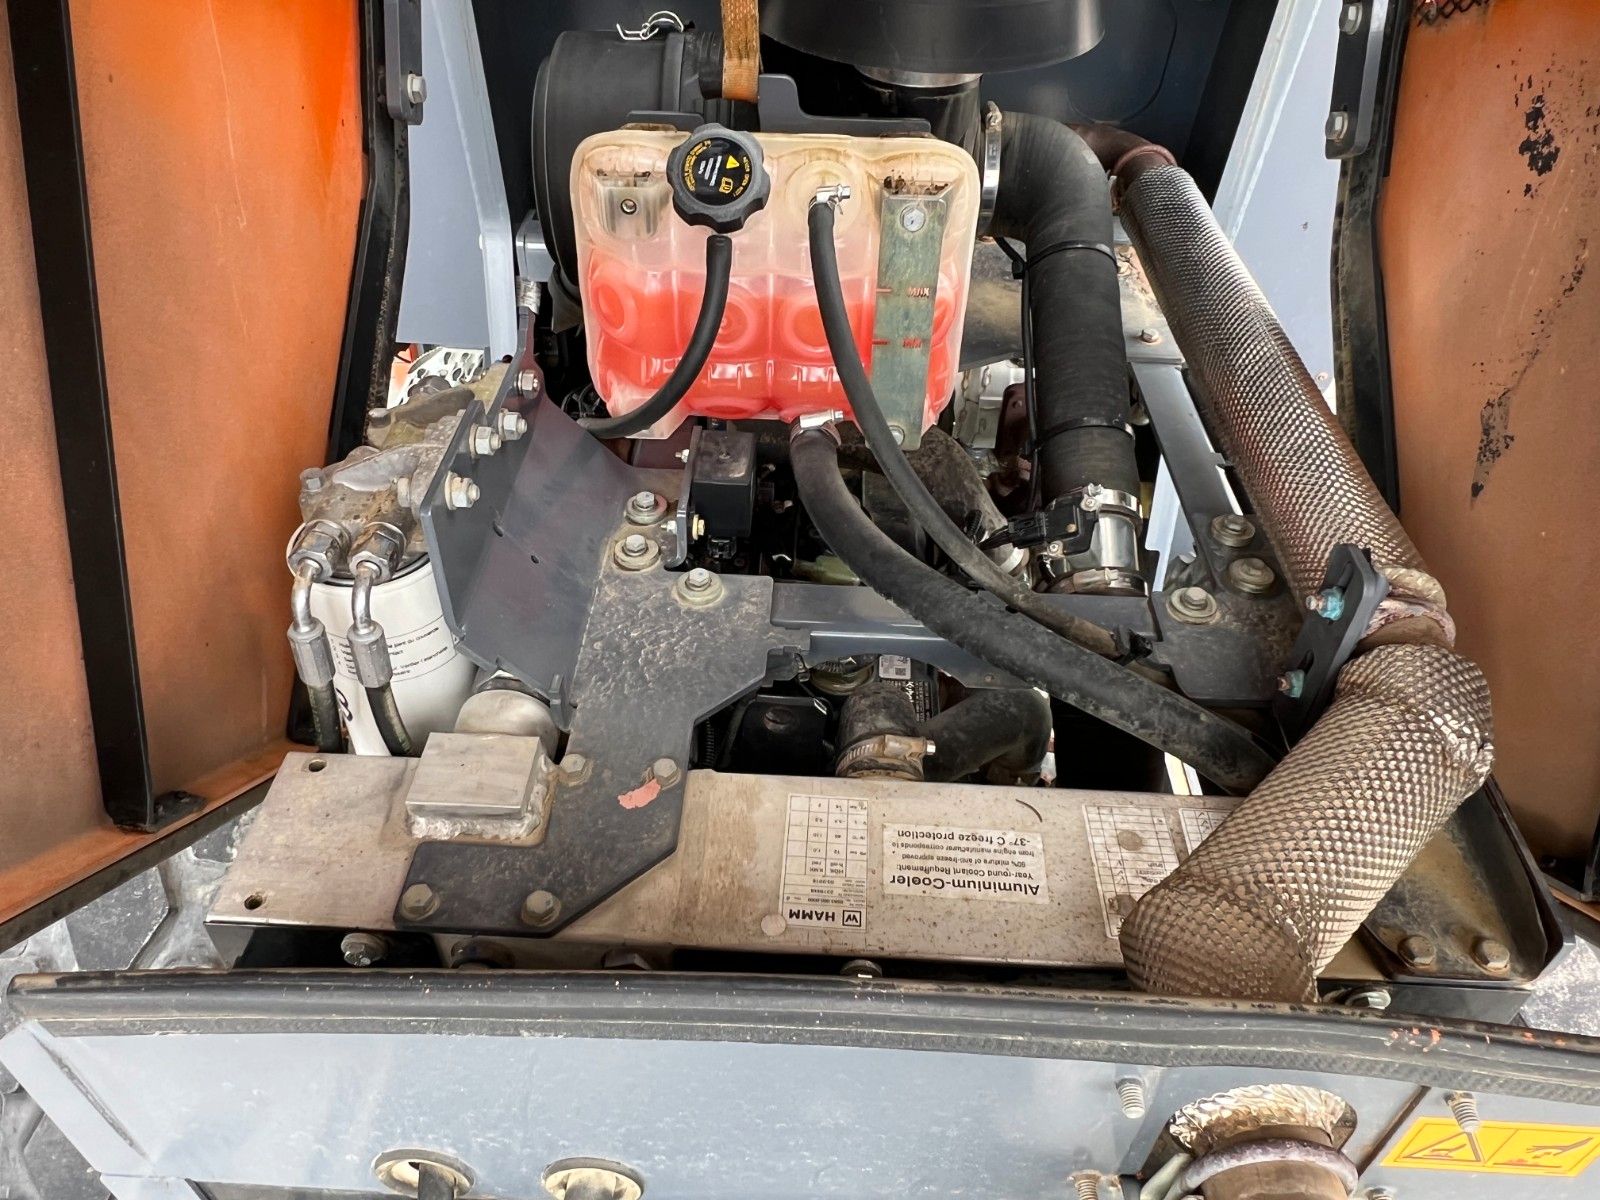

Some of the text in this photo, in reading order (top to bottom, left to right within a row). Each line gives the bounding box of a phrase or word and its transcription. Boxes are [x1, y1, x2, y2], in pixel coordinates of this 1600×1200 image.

[898, 830, 1030, 846] -37° C freeze protection
[896, 864, 1033, 880] Year-round Coolant Requirement:
[890, 875, 1040, 896] Aluminium-Cooler
[789, 909, 835, 922] HAMM
